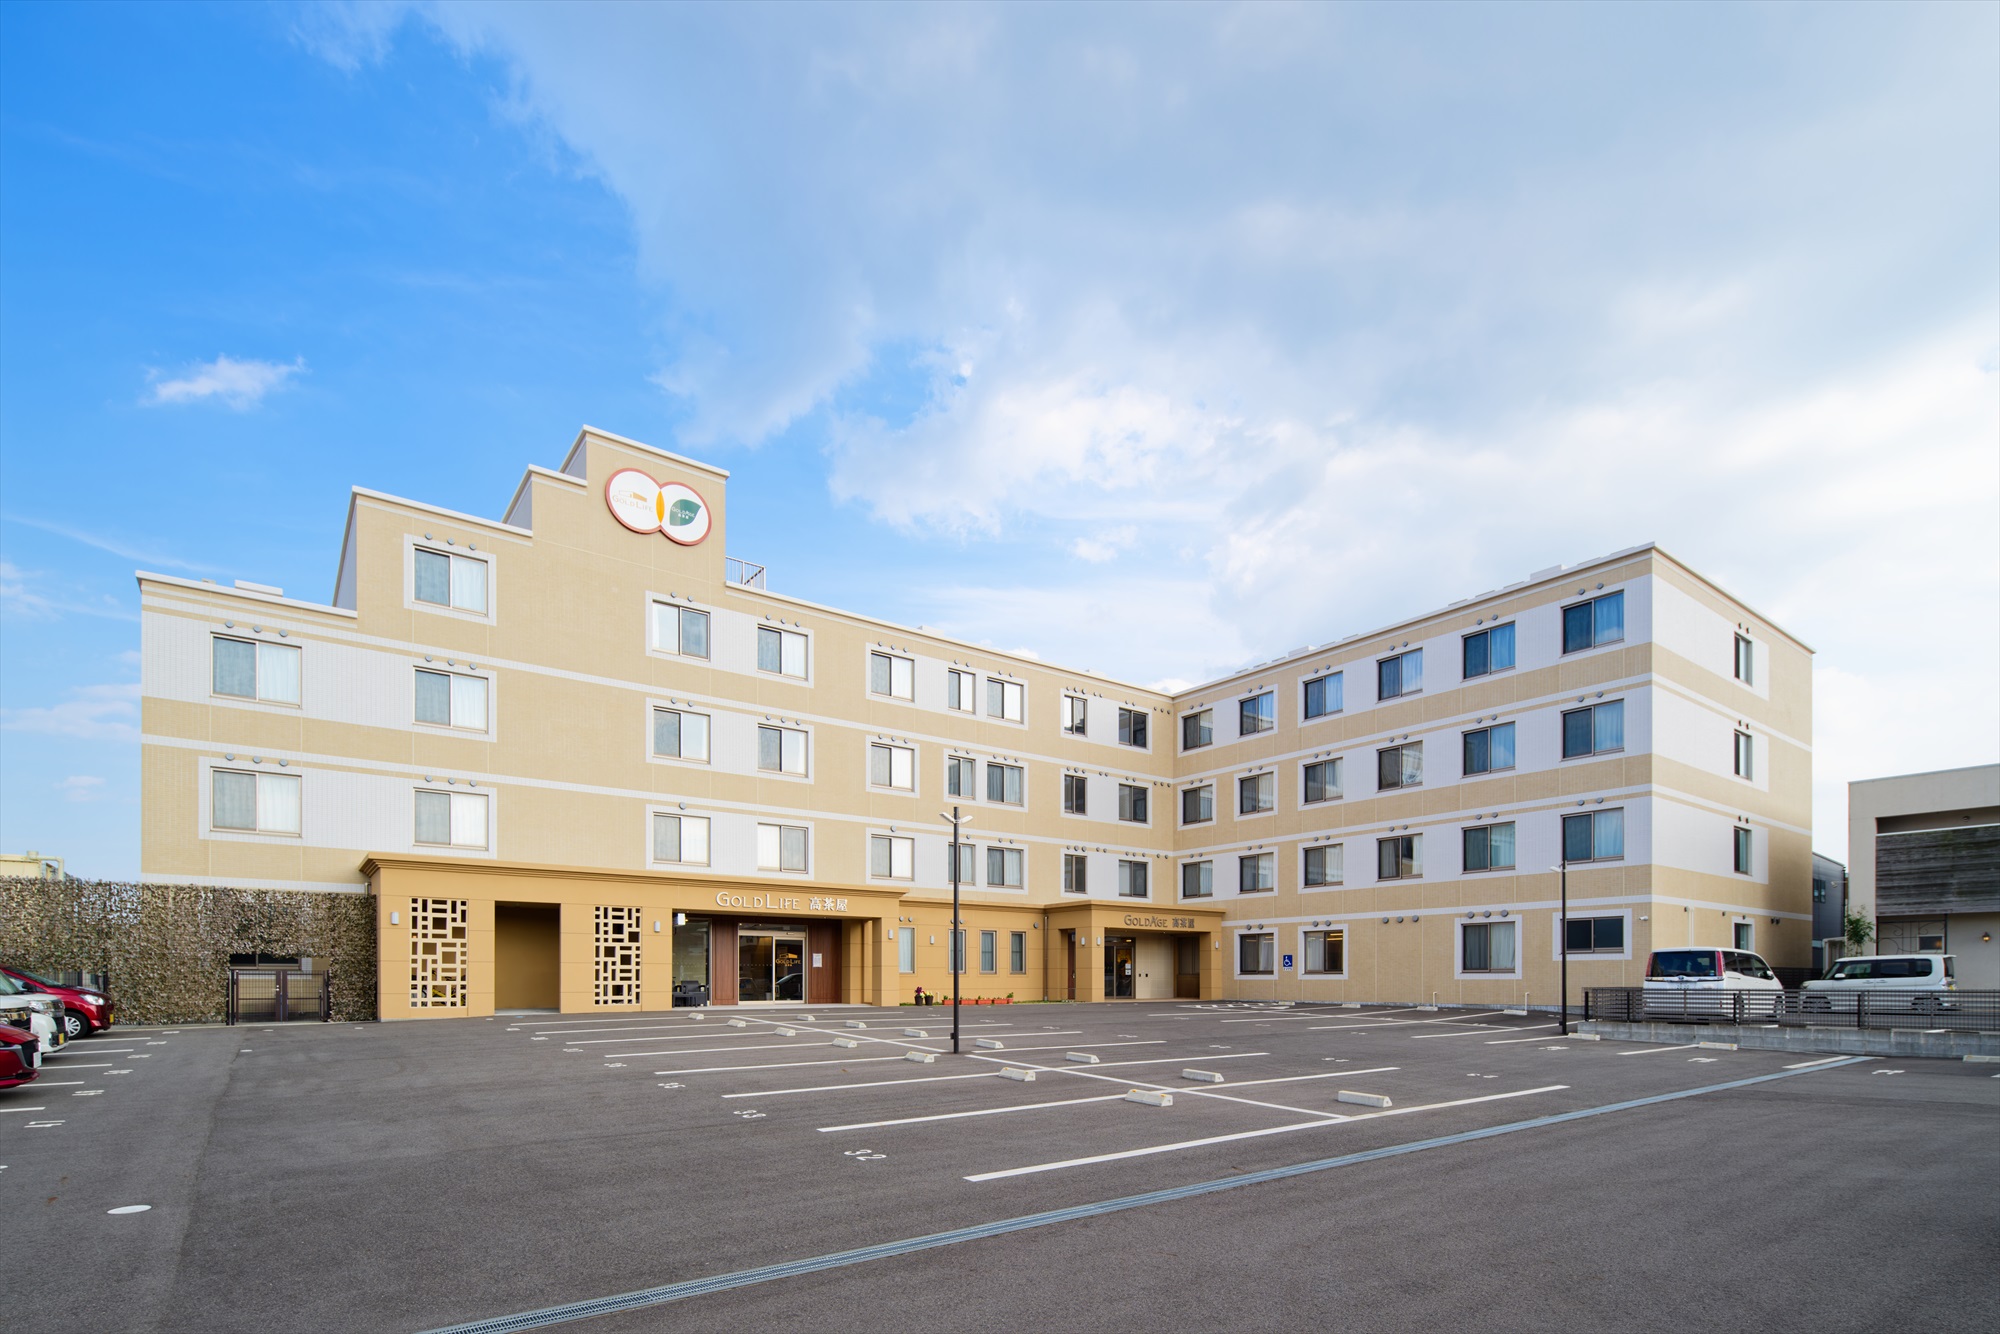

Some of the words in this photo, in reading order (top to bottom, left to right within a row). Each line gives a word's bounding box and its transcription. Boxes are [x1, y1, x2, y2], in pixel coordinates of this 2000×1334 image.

[809, 896, 848, 912] 高茶屋
[733, 1109, 767, 1119] 33
[843, 1149, 887, 1161] 32
